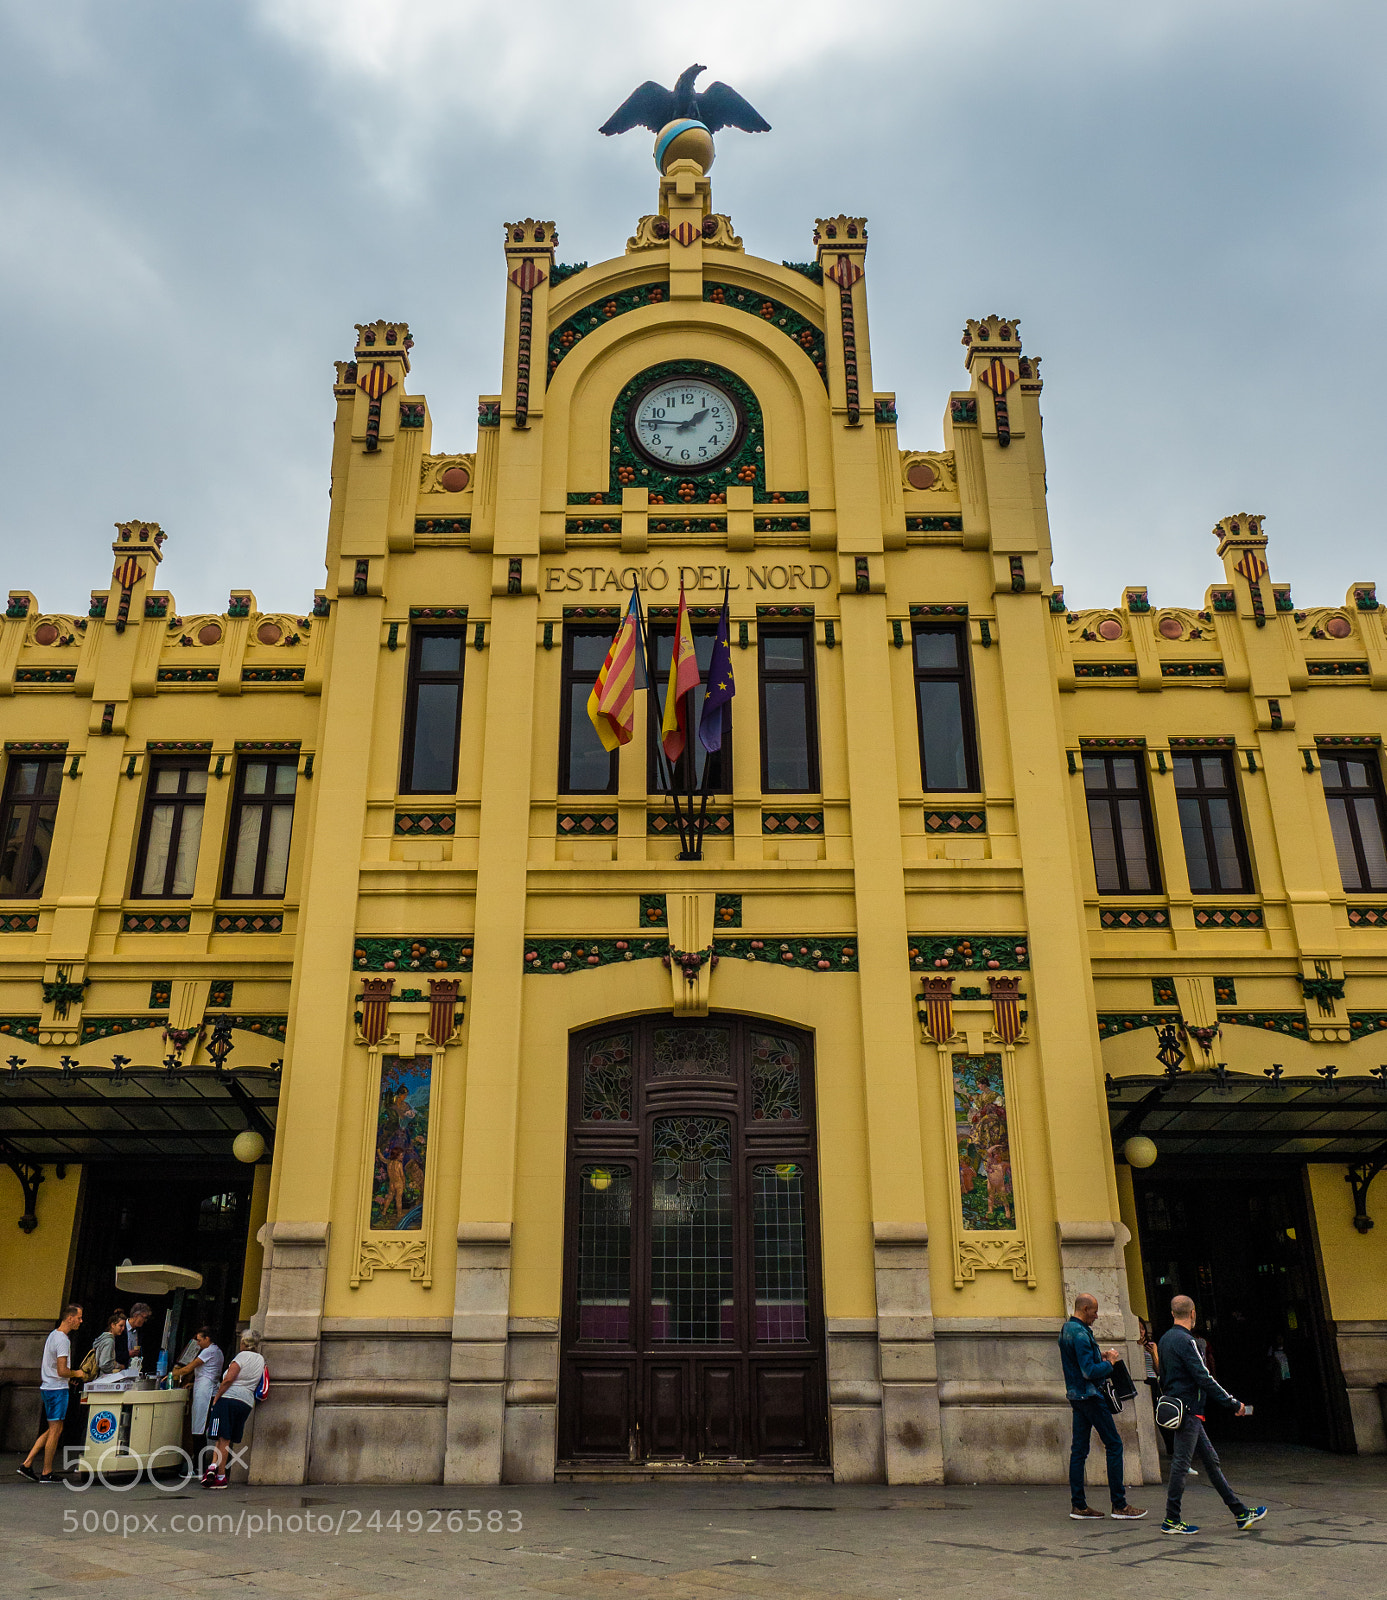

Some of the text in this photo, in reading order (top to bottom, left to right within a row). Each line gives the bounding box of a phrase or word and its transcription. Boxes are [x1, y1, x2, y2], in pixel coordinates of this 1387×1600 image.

[666, 396, 676, 408] 11
[681, 393, 694, 404] 12
[701, 397, 706, 408] 1
[652, 407, 666, 418] 10
[711, 407, 720, 418] 2
[648, 420, 658, 431] 9
[715, 421, 724, 432] 3
[651, 434, 662, 445] 8
[708, 435, 720, 445] 4
[664, 446, 674, 457] 7
[680, 449, 690, 460] 6
[698, 446, 707, 457] 5
[544, 560, 832, 592] ESTACIÓ DEL NORD
